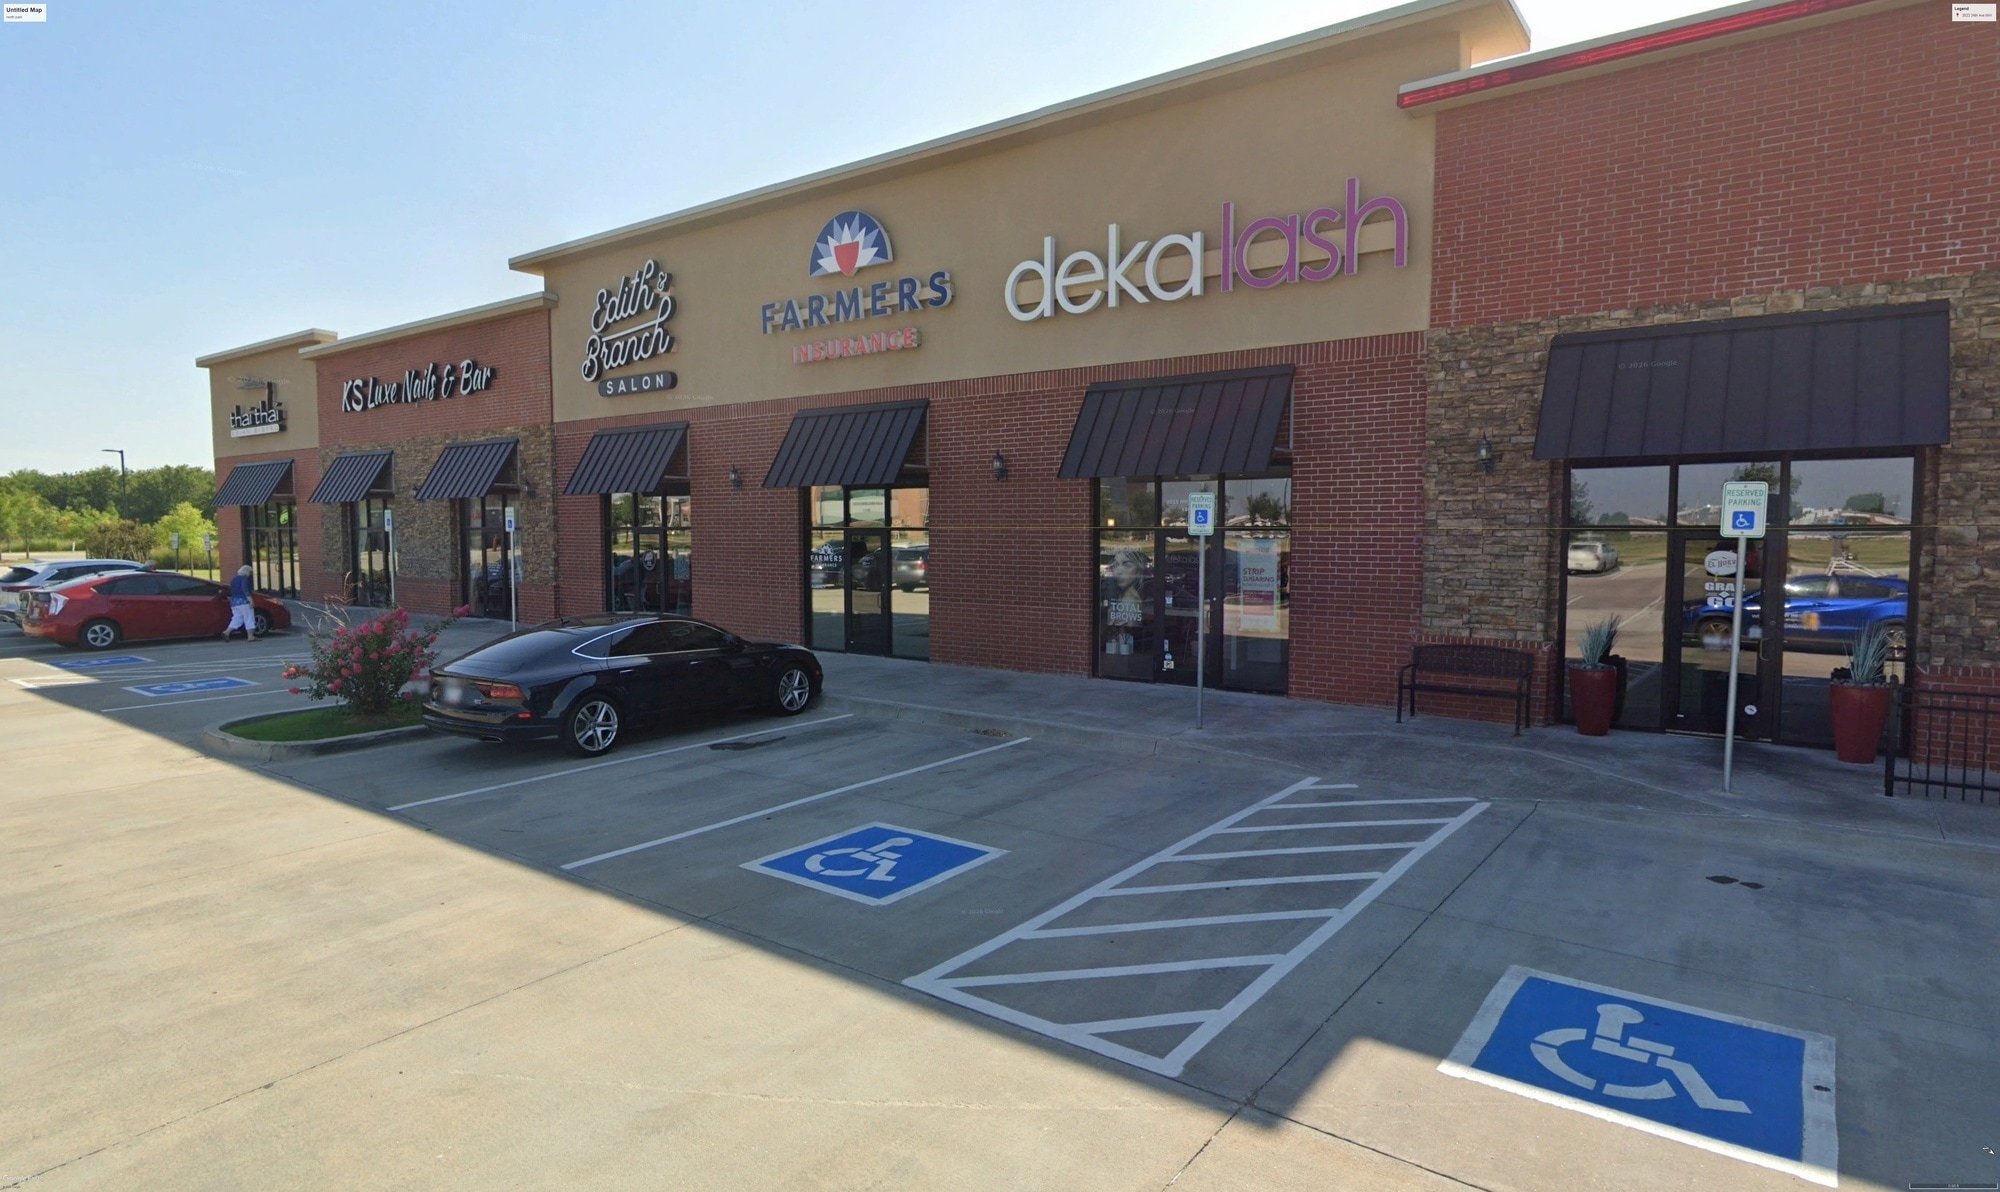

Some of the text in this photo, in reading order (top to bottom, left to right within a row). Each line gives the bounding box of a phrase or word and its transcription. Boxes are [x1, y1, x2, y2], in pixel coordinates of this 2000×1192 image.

[1004, 177, 1408, 321] deka lash
[591, 259, 668, 333] Edith &
[761, 271, 952, 334] FARMERS
[581, 295, 671, 382] Branch
[790, 327, 919, 364] INSURANCE
[342, 359, 491, 412] KS Luxe Nails & Bar
[606, 374, 664, 394] SALON
[810, 554, 843, 562] FARMERS
[1243, 567, 1265, 576] STRIP
[1708, 559, 1738, 568] EL HUEV
[1110, 602, 1142, 613] TOTAL
[1110, 612, 1142, 622] BROWS
